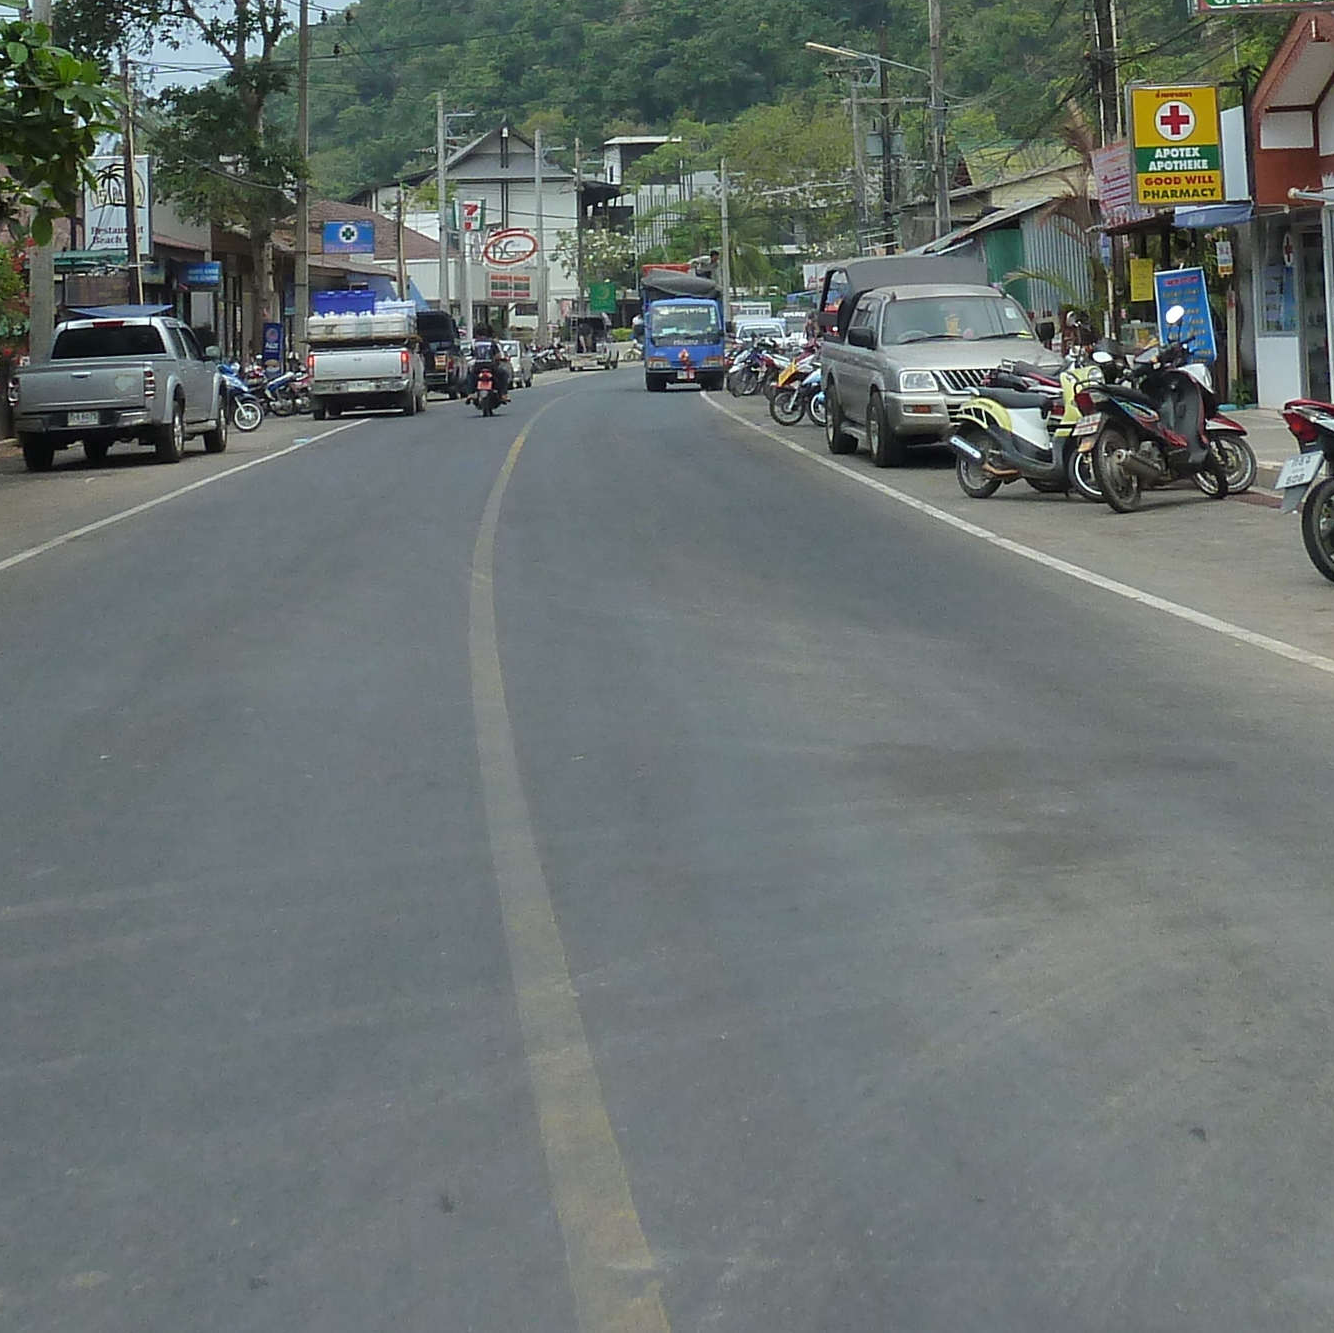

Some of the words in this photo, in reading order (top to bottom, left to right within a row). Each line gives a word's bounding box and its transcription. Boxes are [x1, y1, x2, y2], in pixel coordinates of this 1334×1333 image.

[1155, 147, 1201, 159] APOTEX
[1149, 159, 1209, 171] APOTHEKE
[1145, 177, 1182, 186] GOOD
[1185, 175, 1214, 184] WILL
[1143, 188, 1216, 199] PHARMACY
